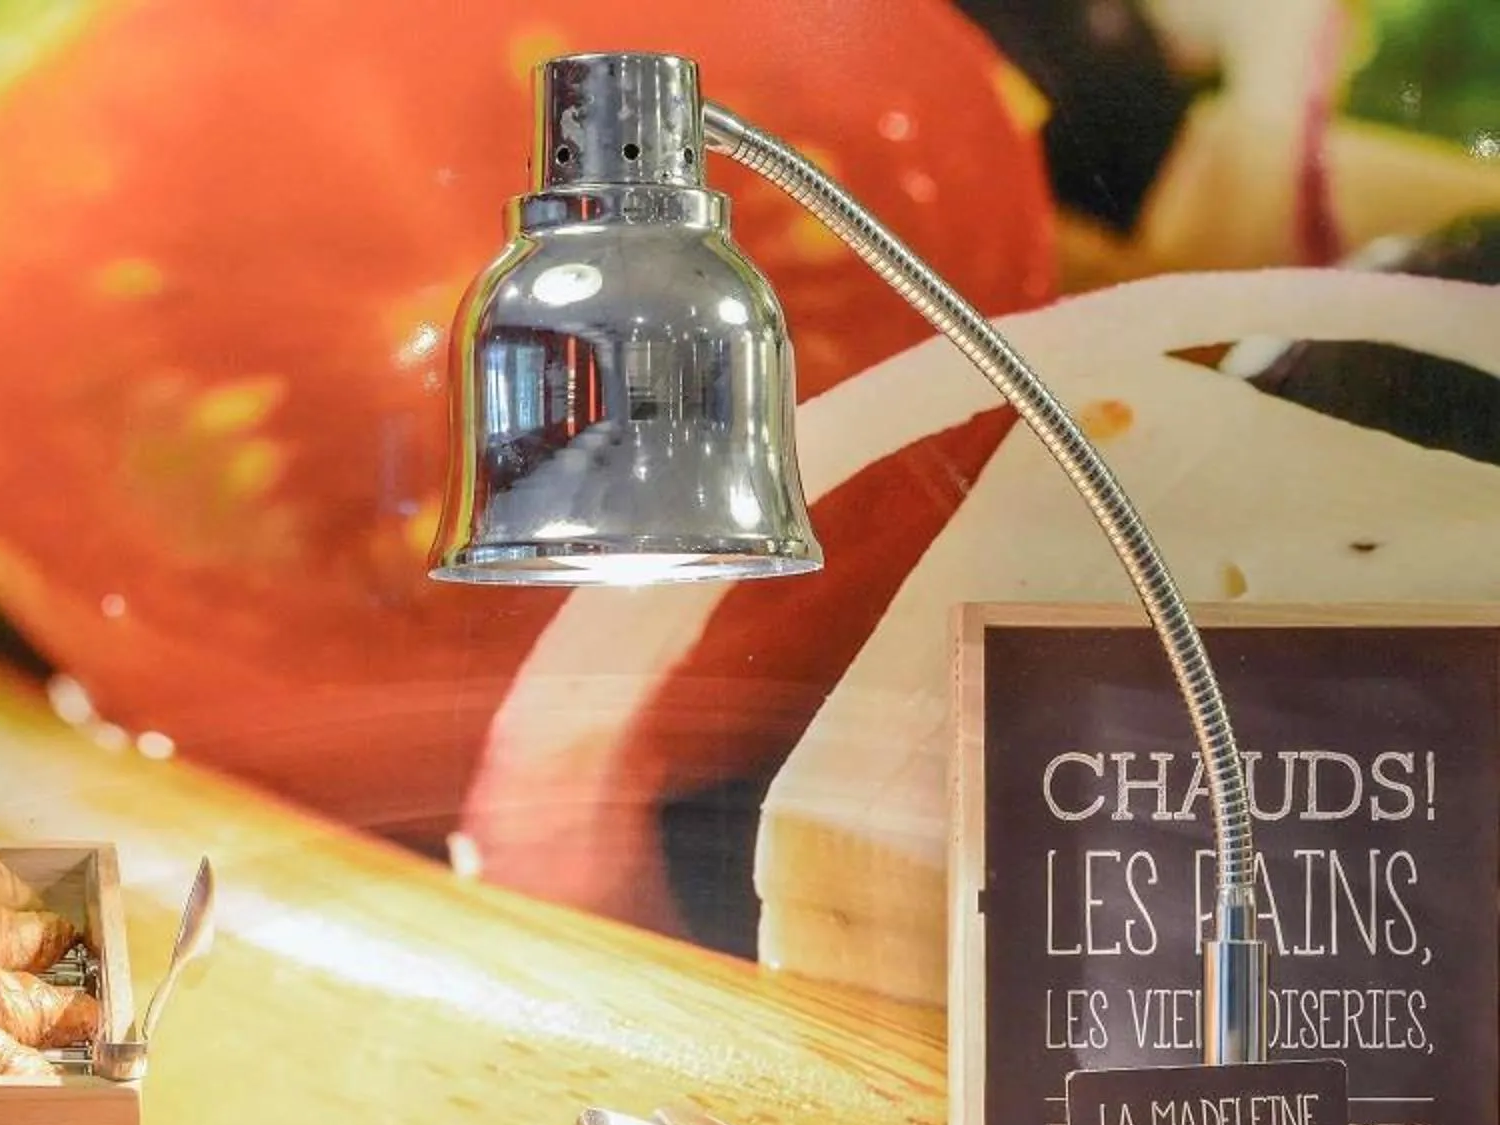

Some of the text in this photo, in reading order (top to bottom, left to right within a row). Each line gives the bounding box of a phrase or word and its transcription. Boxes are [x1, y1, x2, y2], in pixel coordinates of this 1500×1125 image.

[1046, 848, 1433, 965] LES PAINS,
[1046, 988, 1109, 1050] LES
